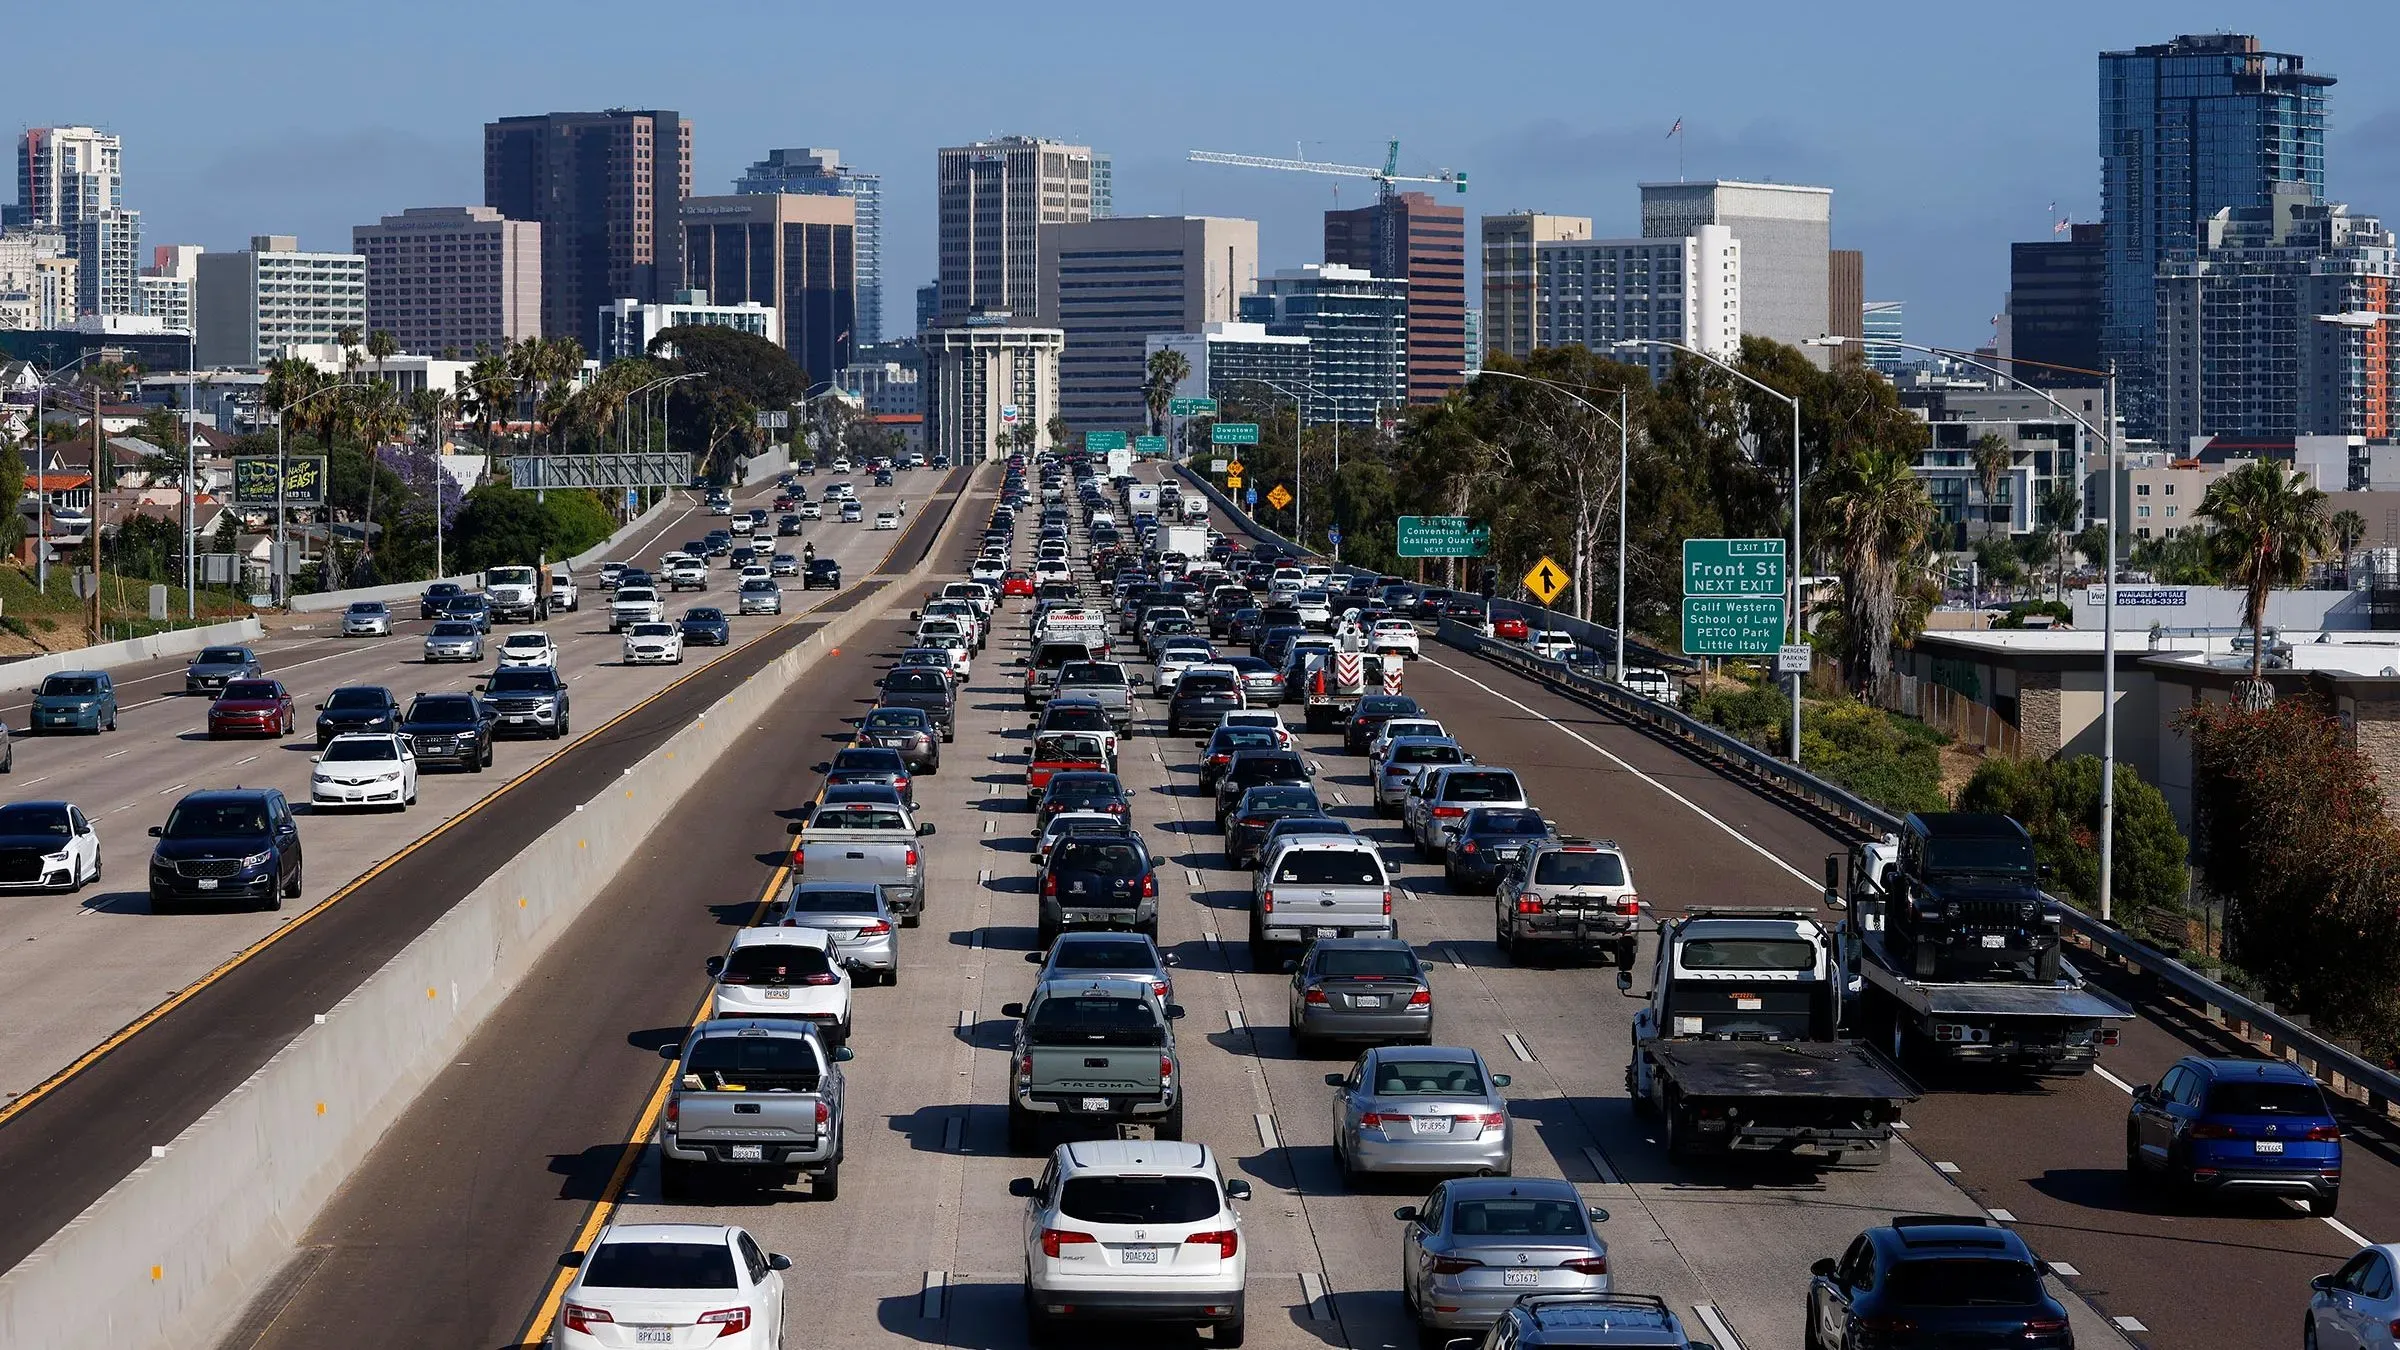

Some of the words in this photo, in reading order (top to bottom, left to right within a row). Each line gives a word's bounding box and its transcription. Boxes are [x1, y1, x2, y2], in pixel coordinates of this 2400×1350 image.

[1407, 527, 1460, 535] Convention
[1403, 536, 1443, 545] Gaslamp
[1764, 542, 1777, 552] 17
[1692, 562, 1745, 576] Front
[1756, 562, 1777, 576] St
[1695, 580, 1735, 591] NEXT
[1740, 580, 1774, 591] EXIT
[1692, 602, 1721, 611] Calif
[1726, 602, 1776, 611] Western
[1690, 615, 1730, 624] School
[1736, 615, 1748, 624] of
[1754, 615, 1778, 624] Law
[1697, 628, 1737, 637] PETCO
[1742, 628, 1770, 637] Park
[1699, 640, 1733, 650] Little
[1739, 640, 1768, 652] Italy
[1125, 1251, 1156, 1262] 9DAE923
[1506, 1273, 1538, 1283] 9KST673
[638, 1331, 672, 1343] 8PKJ118
